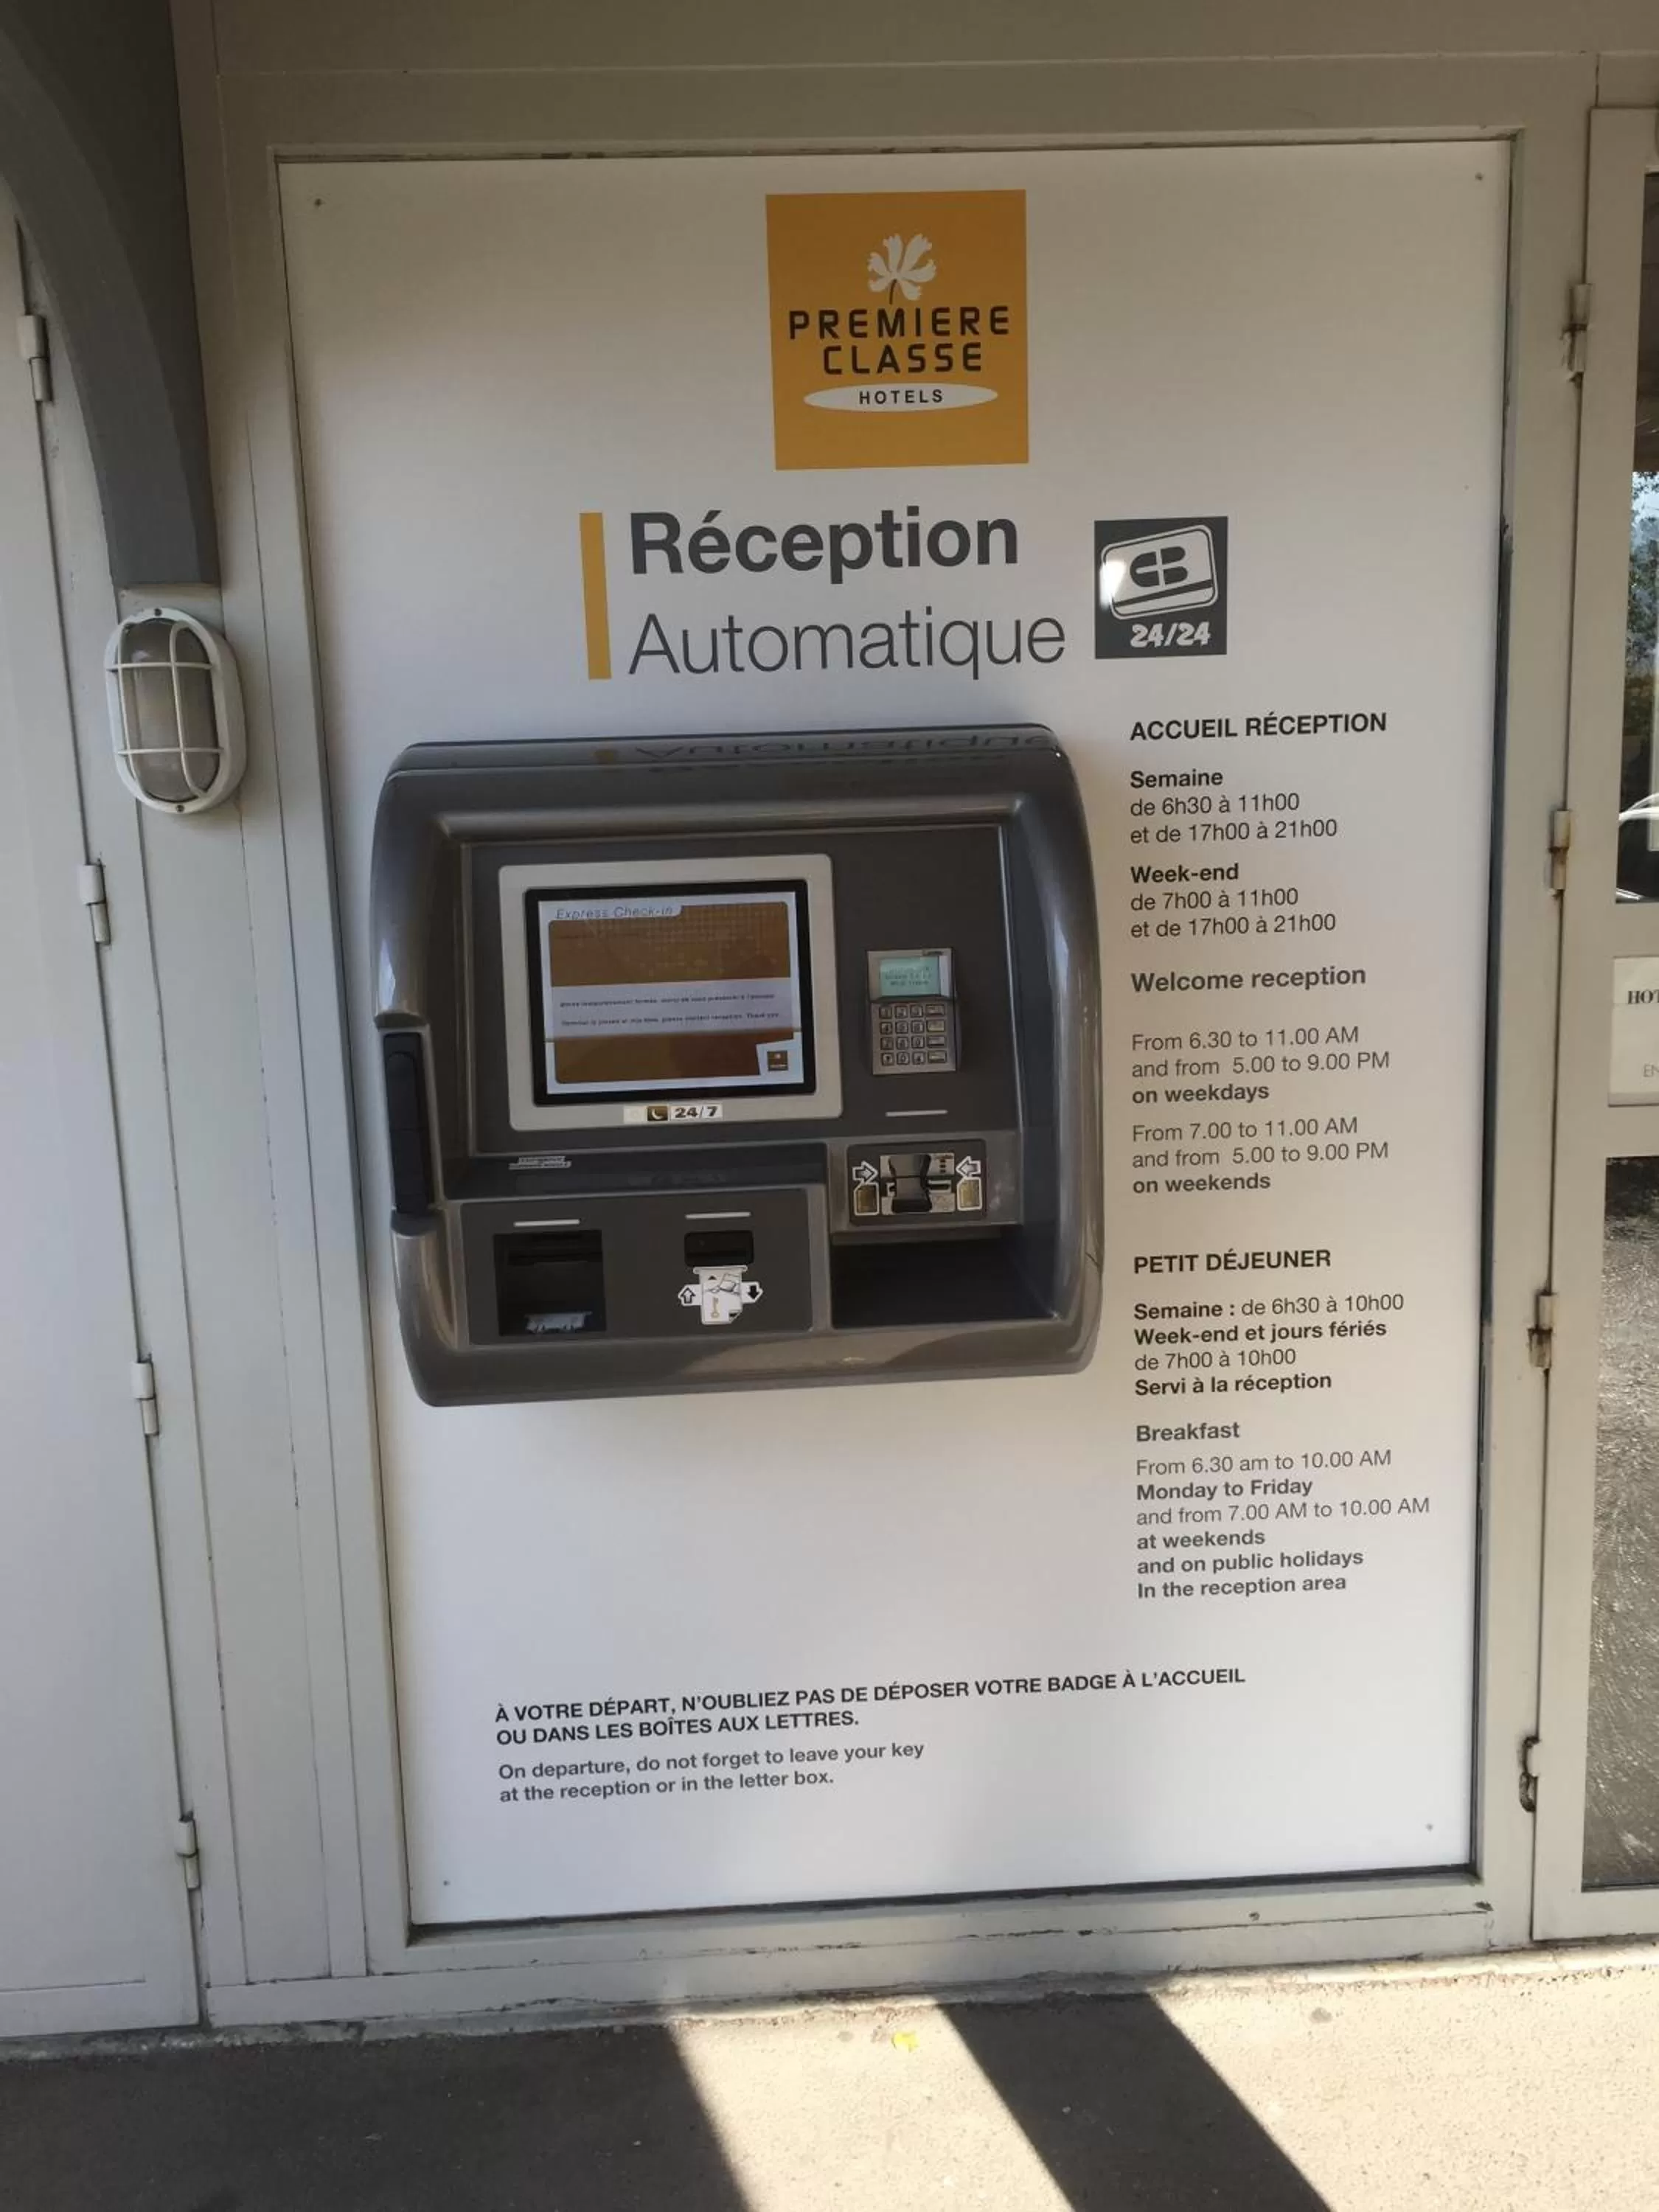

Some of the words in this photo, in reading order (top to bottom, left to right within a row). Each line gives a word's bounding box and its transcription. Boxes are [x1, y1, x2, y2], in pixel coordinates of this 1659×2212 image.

[789, 306, 1009, 340] PREMIERE
[824, 342, 981, 375] CLASSE
[860, 389, 942, 404] HOTELS
[630, 506, 1018, 584] Réception
[628, 606, 1065, 680] Automatique
[1130, 622, 1211, 649] 24/24
[1130, 718, 1238, 740] ACCUEIL
[1246, 712, 1386, 736] RÉCEPTION
[1130, 768, 1223, 789] Semaine
[1130, 798, 1155, 816] de
[1162, 796, 1212, 815] 6h30
[1219, 795, 1231, 813] à
[1239, 793, 1299, 812] 11h00
[1130, 827, 1149, 844] et
[1156, 825, 1181, 843] de
[1189, 822, 1249, 841] 17h00
[1256, 821, 1268, 839] à
[1275, 818, 1337, 838] 21h00
[1130, 863, 1239, 883] Week-end
[1131, 894, 1156, 911] de
[1162, 891, 1211, 909] 7h00
[1218, 890, 1230, 908] à
[1237, 888, 1298, 907] 11h00
[556, 908, 609, 920] Express
[613, 905, 674, 918] Check-in
[1131, 922, 1150, 938] et
[1156, 920, 1181, 937] de
[1189, 917, 1249, 936] 17h00
[1256, 916, 1268, 933] à
[1274, 914, 1335, 932] 21h00
[1130, 971, 1243, 992] Welcome
[1252, 966, 1366, 990] reception
[1133, 1034, 1182, 1051] From
[1189, 1031, 1231, 1049] 6.30
[1239, 1032, 1257, 1047] to
[1266, 1028, 1319, 1046] 11.00
[1325, 1026, 1358, 1044] AM
[1133, 1060, 1168, 1077] and
[1175, 1059, 1219, 1077] from
[1233, 1055, 1275, 1074] 5.00
[1281, 1056, 1301, 1071] to
[1307, 1053, 1350, 1071] 9.00
[1358, 1051, 1389, 1069] PM
[1133, 1091, 1158, 1103] on
[1164, 1084, 1269, 1103] weekdays
[673, 1105, 719, 1119] 24/7
[1133, 1125, 1182, 1142] From
[1190, 1121, 1231, 1139] 7.00
[1238, 1122, 1257, 1138] to
[1265, 1119, 1318, 1136] 11.00
[1324, 1116, 1357, 1134] AM
[1133, 1150, 1168, 1168] and
[1175, 1150, 1220, 1166] from
[1232, 1147, 1274, 1164] 5.00
[1281, 1147, 1301, 1162] to
[1307, 1143, 1349, 1161] 9.00
[1357, 1141, 1388, 1159] PM
[1133, 1180, 1158, 1194] on
[1165, 1172, 1270, 1192] weekends
[1134, 1254, 1199, 1274] PETIT
[1206, 1248, 1330, 1271] DÉJEUNER
[1134, 1301, 1222, 1320] Semaine
[1242, 1299, 1265, 1315] de
[1272, 1297, 1319, 1314] 6h30
[1326, 1295, 1338, 1313] à
[1345, 1294, 1404, 1311] 10h00
[1134, 1325, 1238, 1345] Week-end
[1245, 1325, 1265, 1340] et
[1270, 1324, 1323, 1343] jours
[1329, 1320, 1386, 1338] fériés
[1135, 1354, 1159, 1371] de
[1165, 1352, 1212, 1368] 7h00
[1219, 1350, 1231, 1367] à
[1237, 1349, 1295, 1366] 10h00
[1135, 1378, 1186, 1396] Servi
[1193, 1377, 1203, 1393] à
[1211, 1377, 1228, 1392] la
[1235, 1373, 1331, 1394] réception
[1136, 1422, 1239, 1442] Breakfast
[1137, 1459, 1185, 1475] From
[1192, 1456, 1233, 1474] 6.30
[1239, 1458, 1268, 1471] am
[1275, 1455, 1294, 1470] to
[1301, 1451, 1353, 1469] 10.00
[1360, 1450, 1391, 1466] AM
[1137, 1482, 1218, 1501] Monday
[1223, 1481, 1243, 1496] to
[1251, 1478, 1313, 1497] Friday
[1136, 1507, 1172, 1526] and
[1178, 1507, 1221, 1523] from
[1228, 1504, 1269, 1521] 7.00
[1275, 1502, 1307, 1519] AM
[1314, 1503, 1332, 1517] to
[1340, 1499, 1391, 1516] 10.00
[1398, 1497, 1429, 1514] AM
[1137, 1534, 1156, 1550] at
[1163, 1529, 1265, 1548] weekends
[1138, 1557, 1174, 1574] and
[1181, 1559, 1206, 1572] on
[1213, 1554, 1273, 1574] public
[1280, 1550, 1363, 1568] holidays
[1138, 1583, 1155, 1599] In
[1162, 1582, 1194, 1597] the
[1200, 1577, 1295, 1597] reception
[1302, 1578, 1346, 1591] area
[495, 1703, 509, 1722] À
[514, 1703, 583, 1721] VOTRE
[589, 1697, 675, 1718] DÉPART,
[682, 1691, 790, 1711] N'OUBLIEZ
[796, 1688, 835, 1705] PAS
[841, 1687, 867, 1703] DE
[874, 1681, 969, 1700] DÉPOSER
[975, 1678, 1042, 1695] VOTRE
[1048, 1674, 1116, 1691] BADGE
[1122, 1669, 1135, 1688] À
[1141, 1669, 1245, 1687] L'ACCUEIL
[497, 1729, 526, 1745] OU
[533, 1725, 589, 1743] DANS
[596, 1722, 633, 1739] LES
[639, 1717, 712, 1737] BOÎTES
[718, 1716, 759, 1732] AUX
[765, 1711, 858, 1730] LETTRES.
[498, 1764, 526, 1779] On
[532, 1761, 630, 1780] departure,
[636, 1756, 660, 1771] do
[667, 1754, 698, 1770] not
[702, 1750, 759, 1770] forget
[765, 1750, 784, 1764] to
[790, 1747, 838, 1762] leave
[844, 1747, 886, 1763] your
[892, 1742, 924, 1759] key
[500, 1787, 518, 1803] at
[524, 1786, 554, 1801] the
[560, 1781, 650, 1799] reception
[656, 1781, 675, 1793] or
[681, 1777, 698, 1792] in
[703, 1775, 734, 1790] the
[740, 1773, 789, 1788] letter
[794, 1770, 833, 1784] box.
